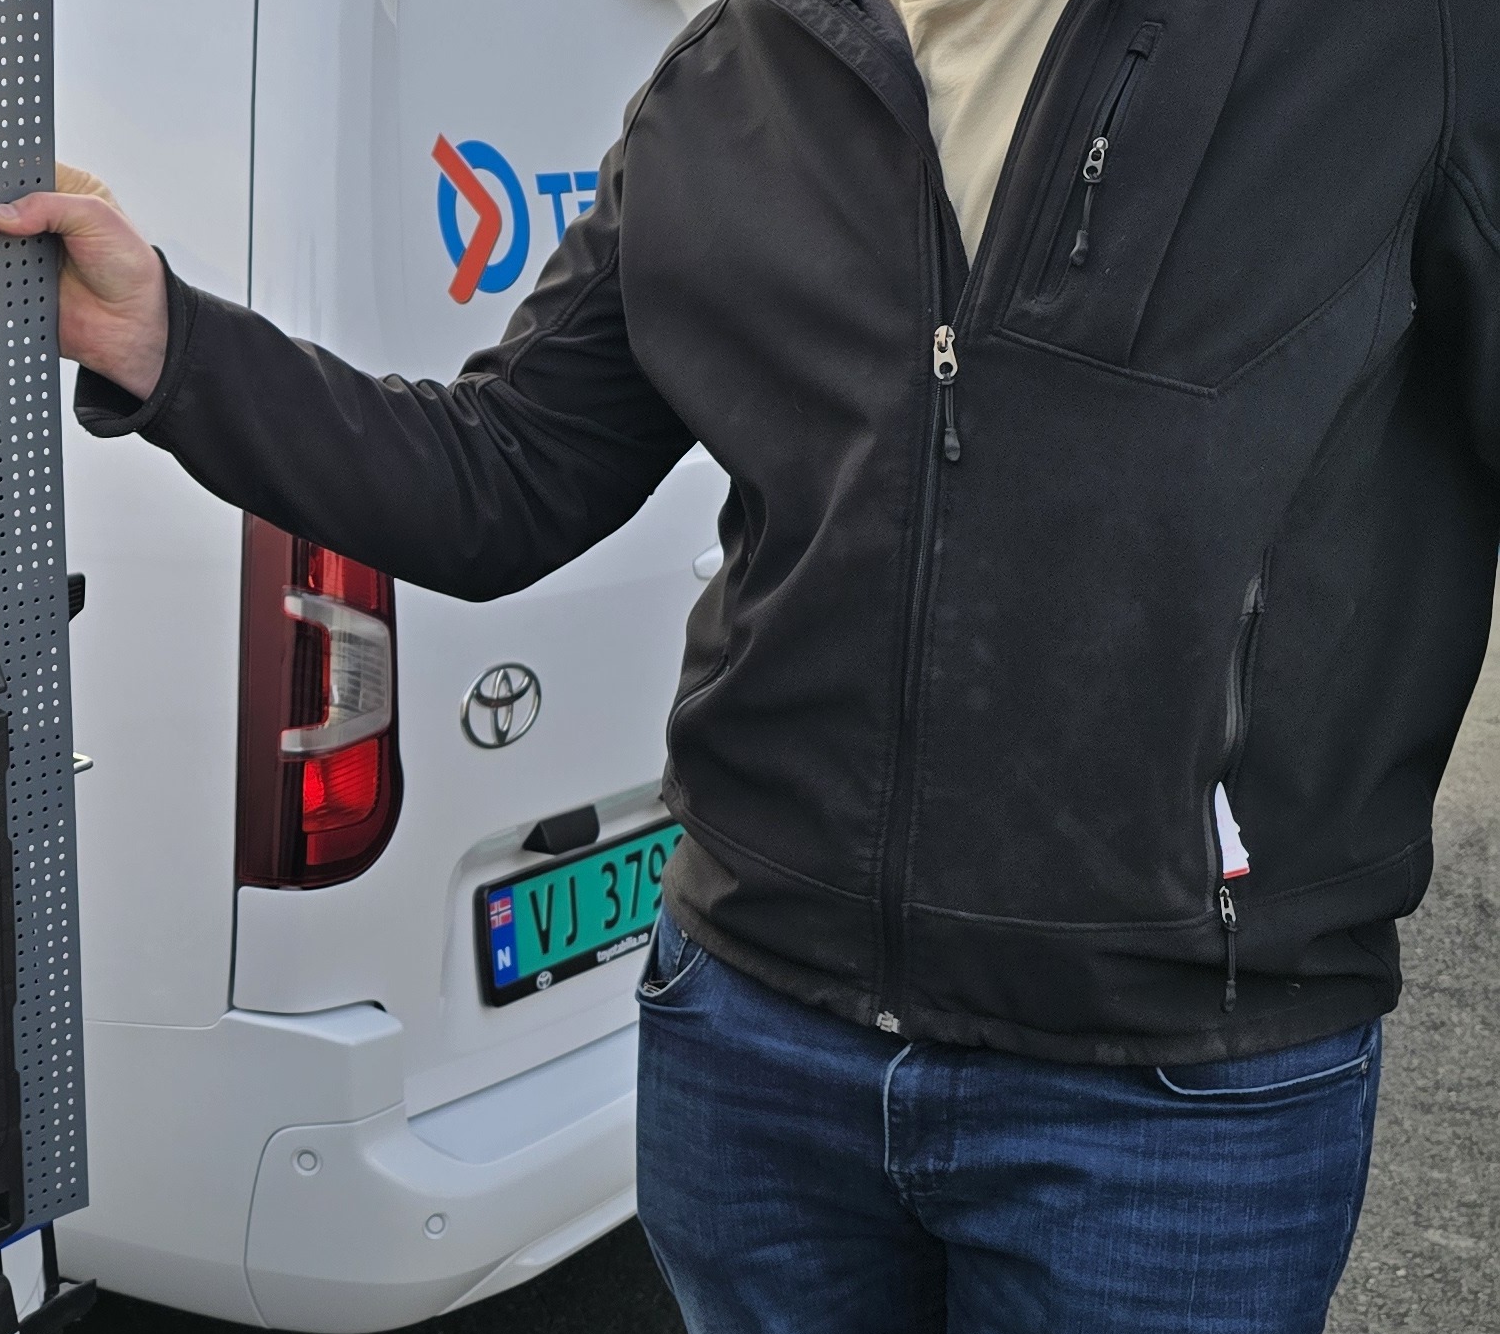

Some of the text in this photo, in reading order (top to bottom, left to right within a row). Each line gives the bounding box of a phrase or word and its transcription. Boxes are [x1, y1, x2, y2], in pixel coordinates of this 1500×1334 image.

[529, 833, 685, 956] VJ 379
[497, 945, 511, 971] N
